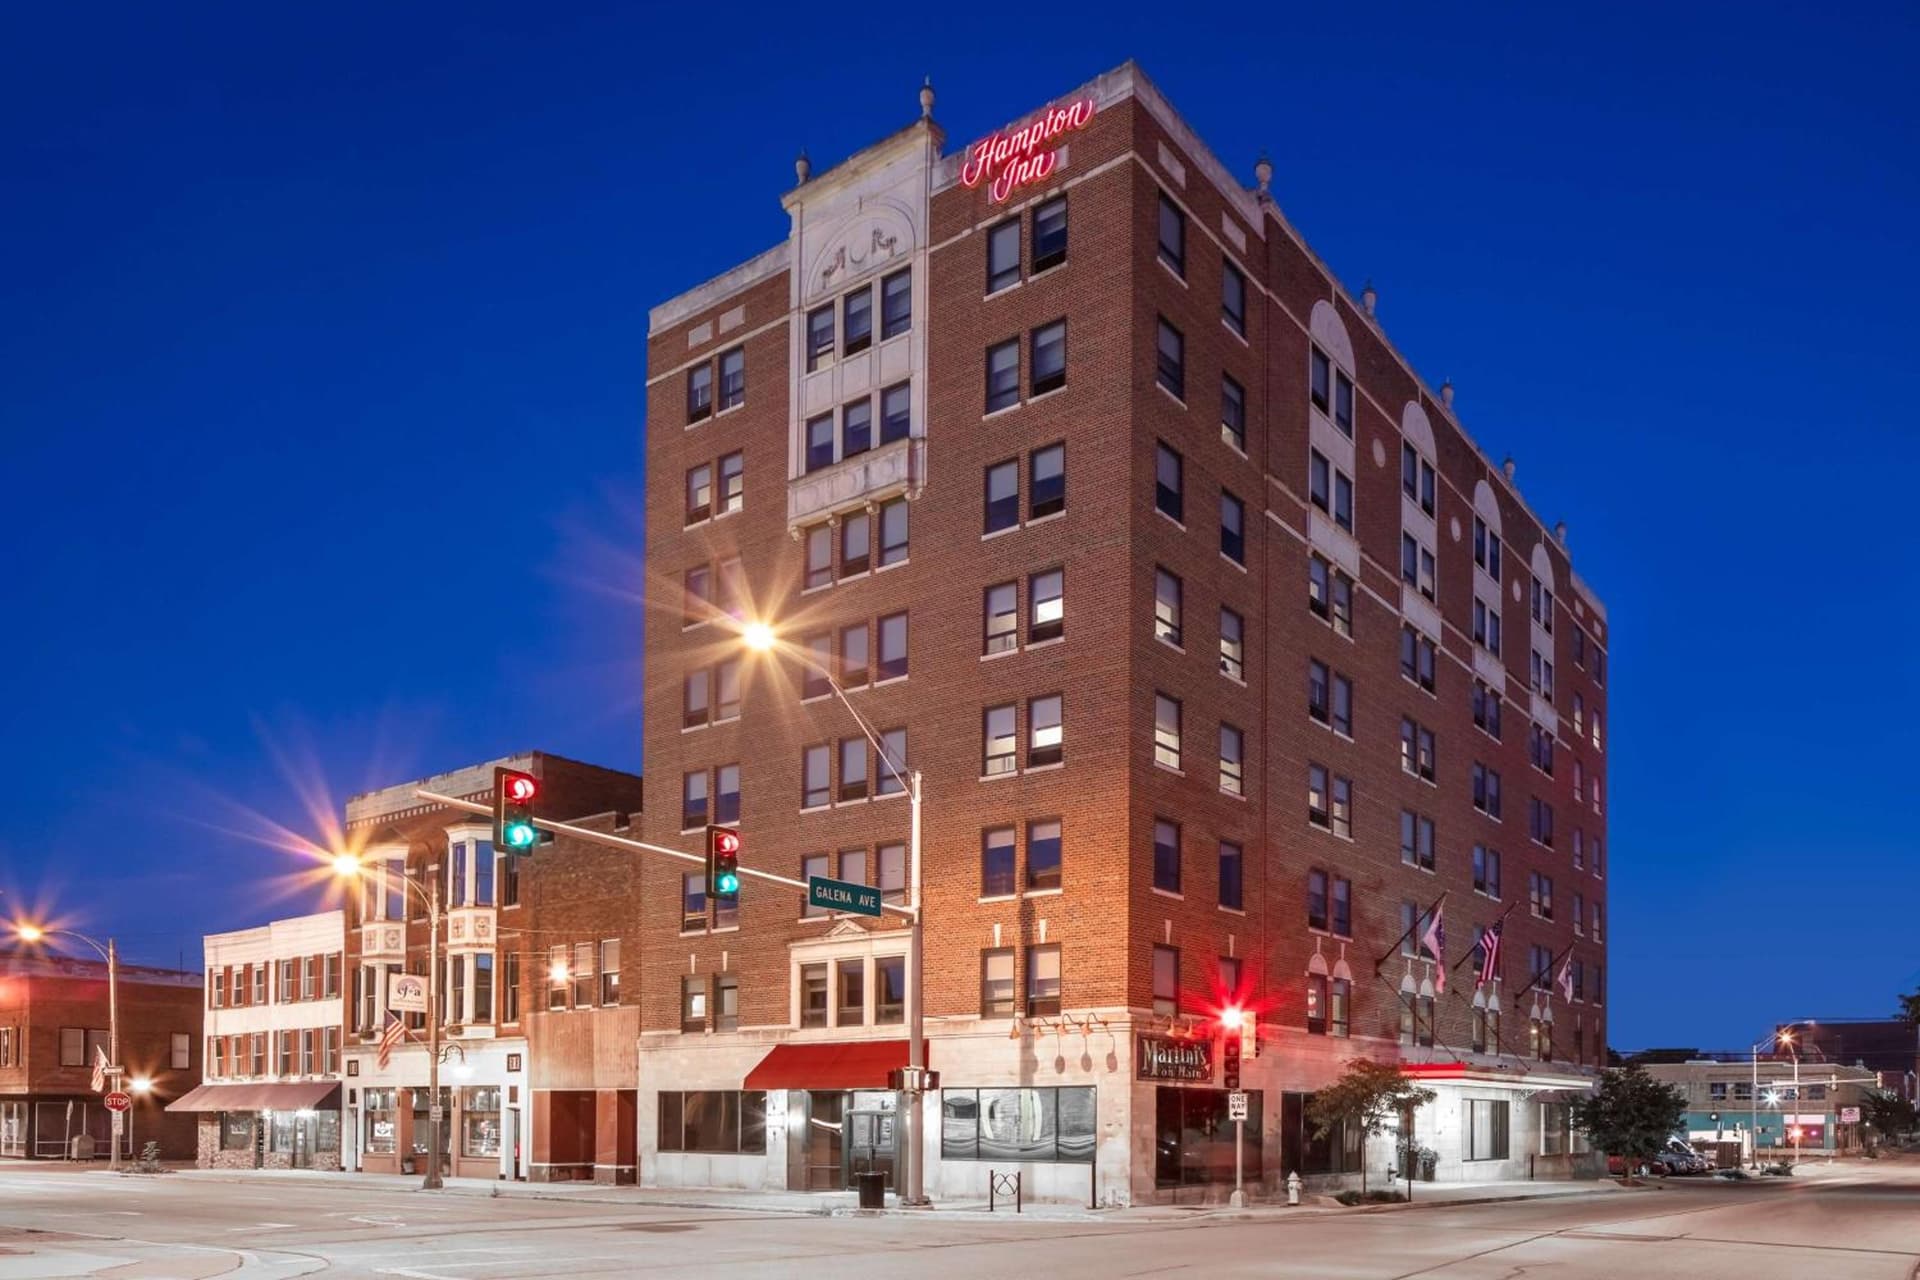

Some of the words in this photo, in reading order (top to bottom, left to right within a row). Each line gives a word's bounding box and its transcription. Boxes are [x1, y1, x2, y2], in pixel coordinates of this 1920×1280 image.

[963, 99, 1093, 186] Hampton
[994, 151, 1056, 201] Inn
[815, 886, 853, 904] GALENA
[858, 894, 877, 908] AVE
[1142, 1039, 1207, 1076] Martini's
[1160, 1067, 1175, 1077] on
[1178, 1065, 1202, 1079] Main
[106, 1097, 129, 1106] STOP
[1231, 1095, 1245, 1103] ONE
